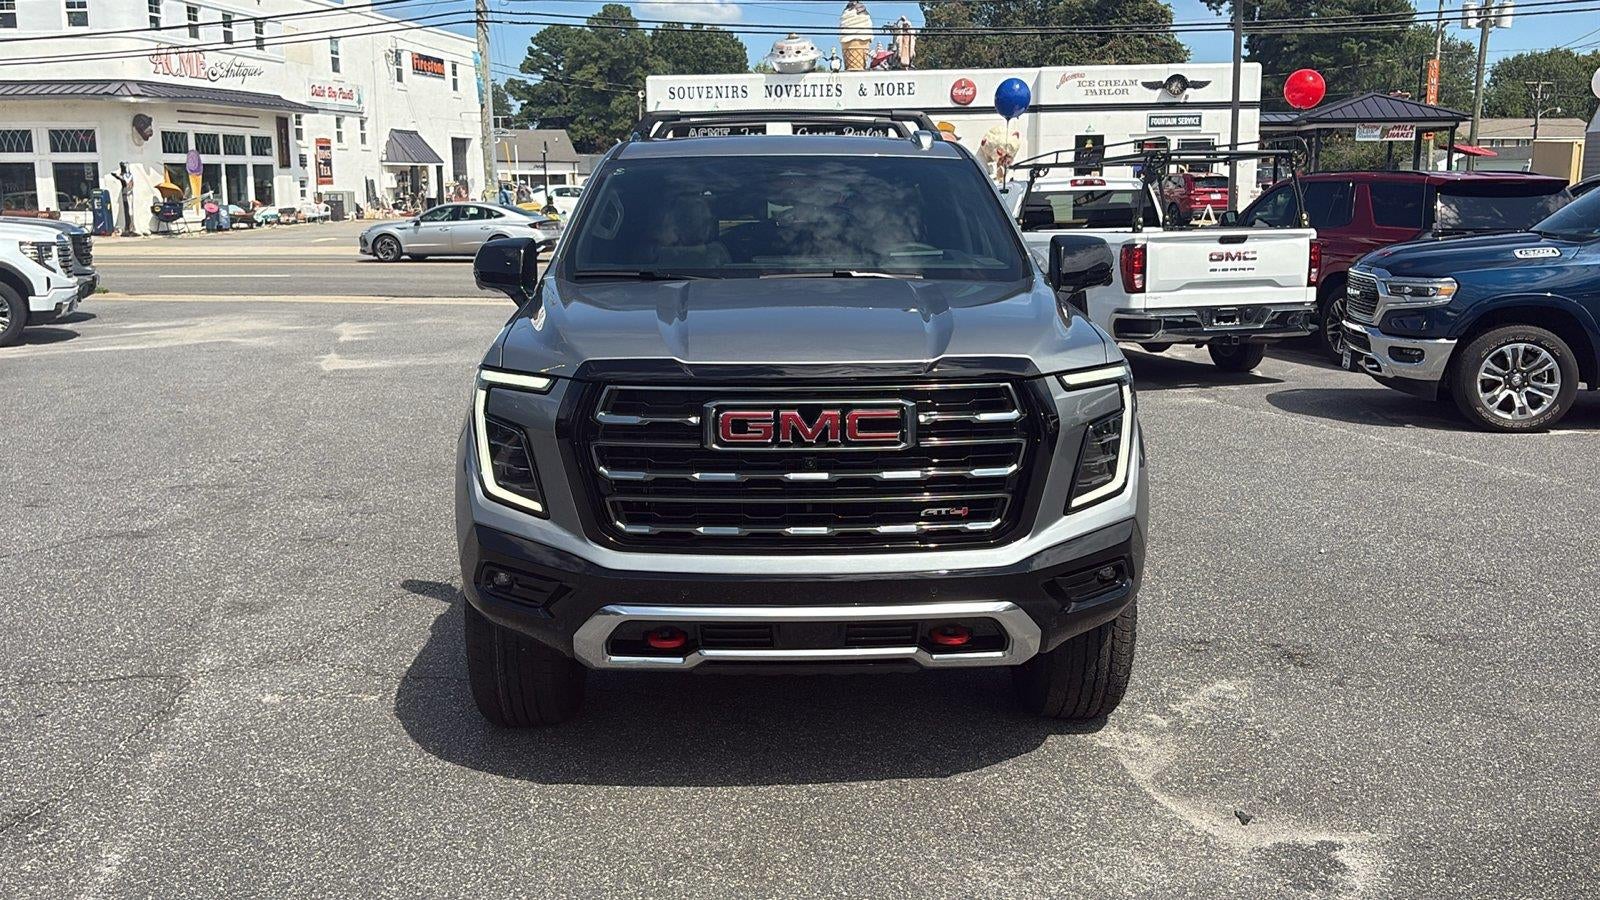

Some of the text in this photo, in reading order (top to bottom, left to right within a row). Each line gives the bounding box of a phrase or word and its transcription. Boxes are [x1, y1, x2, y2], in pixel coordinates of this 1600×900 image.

[148, 43, 264, 84] ACME Antiques
[412, 53, 445, 75] Firestone
[1077, 80, 1096, 88] ICE
[1097, 79, 1139, 87] CREAM
[328, 86, 337, 102] Boy
[338, 87, 354, 100] Paints
[668, 82, 915, 100] SOUVENIRS NOVELTIES & MORE
[1084, 88, 1129, 96] PARLOR
[1151, 116, 1200, 126] FOUNTAIN SERVICE
[1208, 250, 1258, 262] GMC
[719, 410, 901, 443] GMC
[920, 506, 969, 517] AT4
